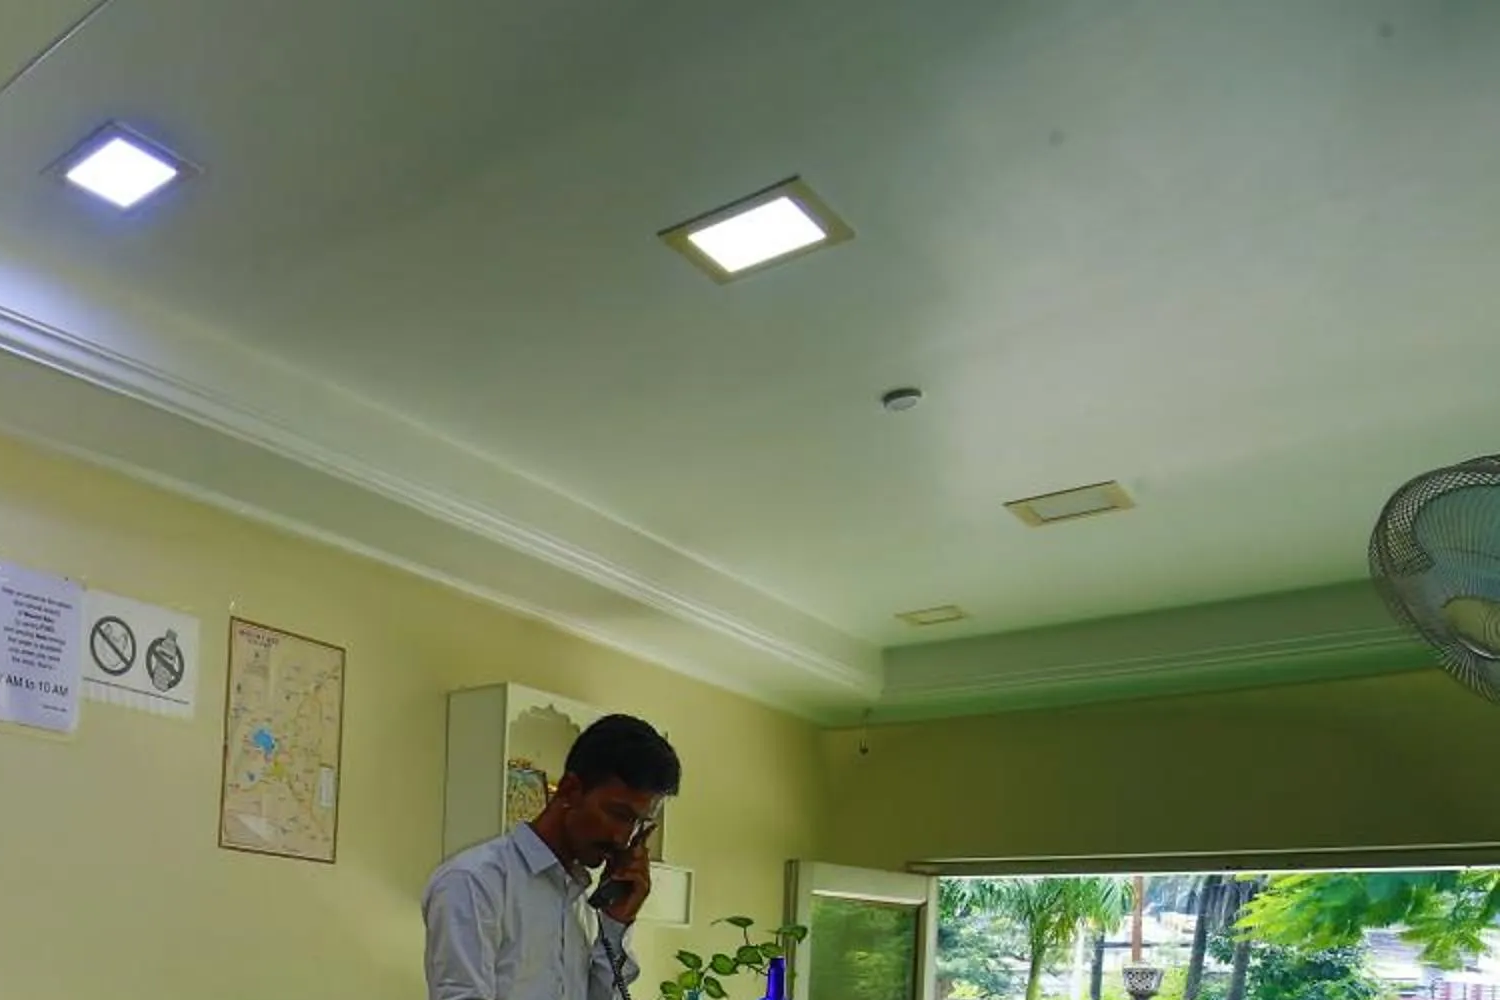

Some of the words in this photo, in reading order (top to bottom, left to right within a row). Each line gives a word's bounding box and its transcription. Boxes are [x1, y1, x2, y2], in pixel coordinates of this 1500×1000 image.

[6, 674, 23, 688] AM
[25, 679, 35, 690] to
[39, 680, 51, 693] 10
[52, 684, 68, 697] AM
